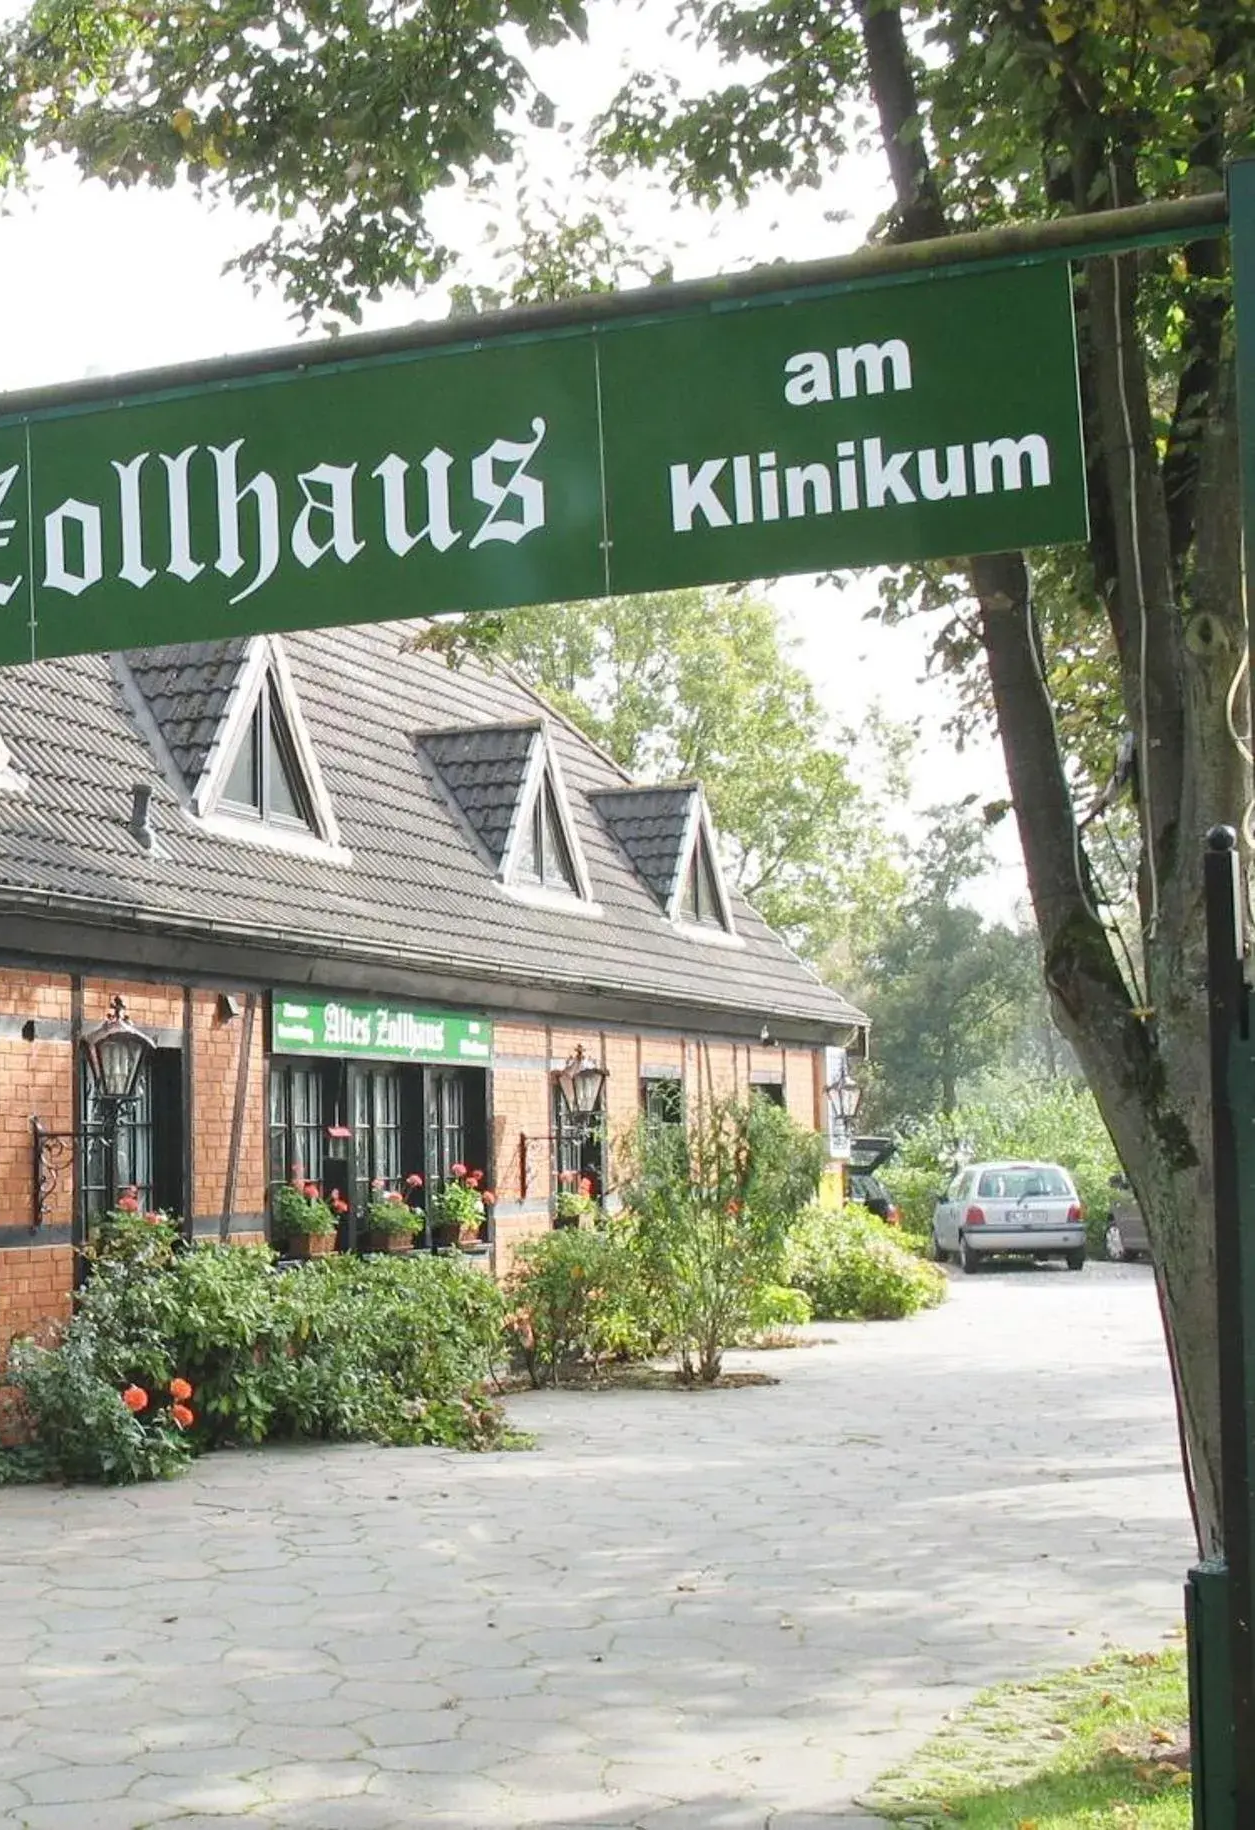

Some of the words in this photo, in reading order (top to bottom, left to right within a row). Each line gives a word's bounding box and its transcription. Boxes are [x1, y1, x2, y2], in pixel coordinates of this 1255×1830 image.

[783, 338, 913, 407] am
[669, 433, 1052, 533] Klinikum
[324, 1003, 371, 1046] Altes
[375, 1008, 445, 1056] Zollhaus
